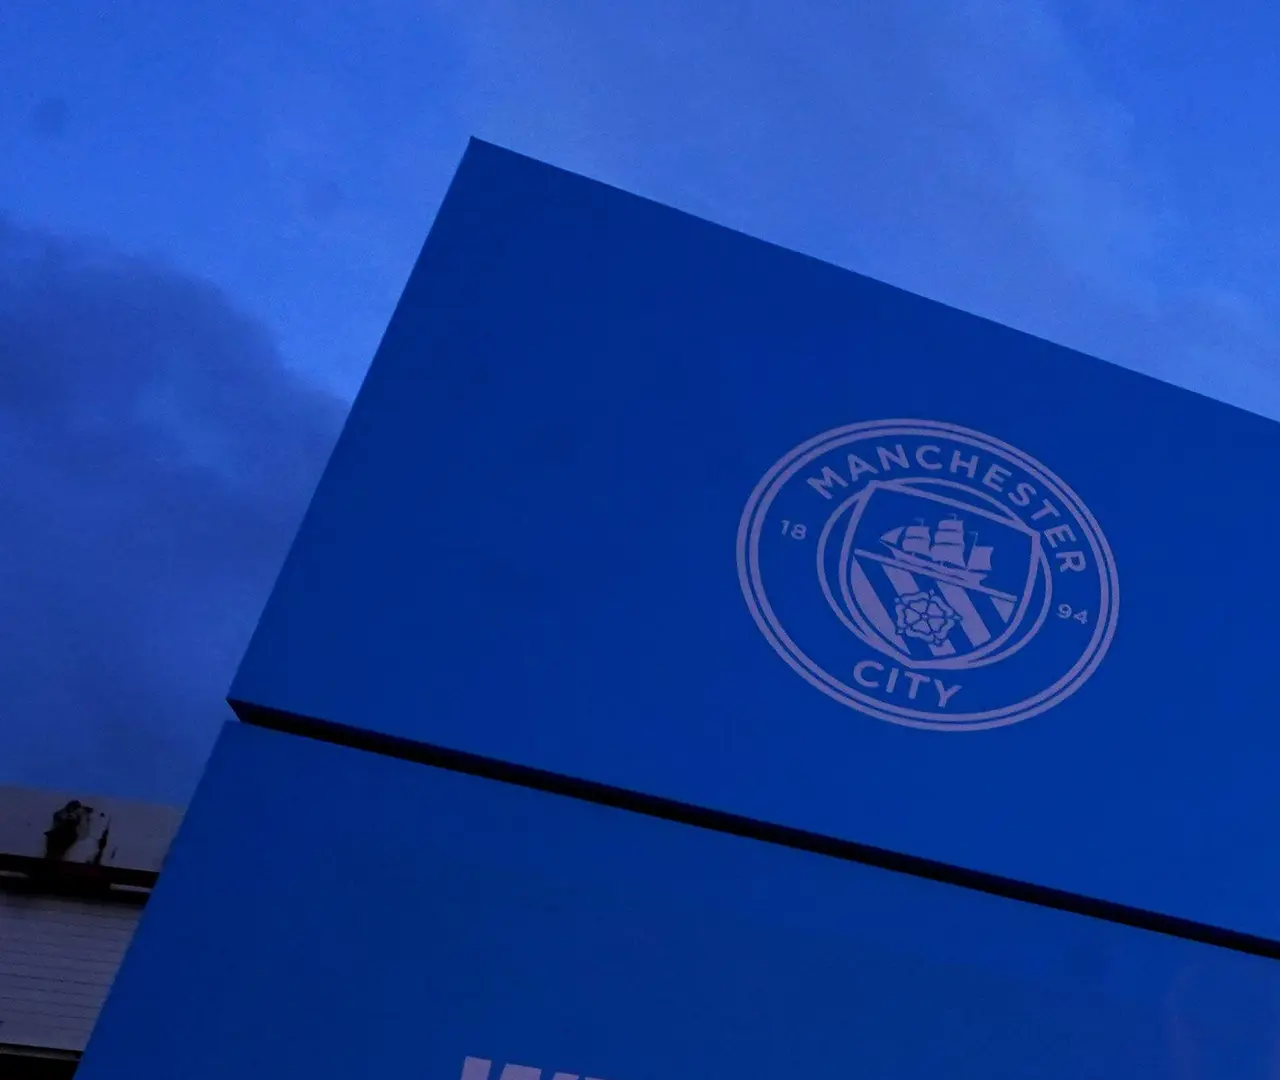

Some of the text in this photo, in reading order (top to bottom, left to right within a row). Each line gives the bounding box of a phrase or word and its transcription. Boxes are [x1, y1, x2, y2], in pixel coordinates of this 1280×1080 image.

[807, 444, 1087, 573] MANCHESTER
[780, 519, 808, 541] 18
[1056, 603, 1089, 626] 94
[852, 659, 963, 708] CITY
